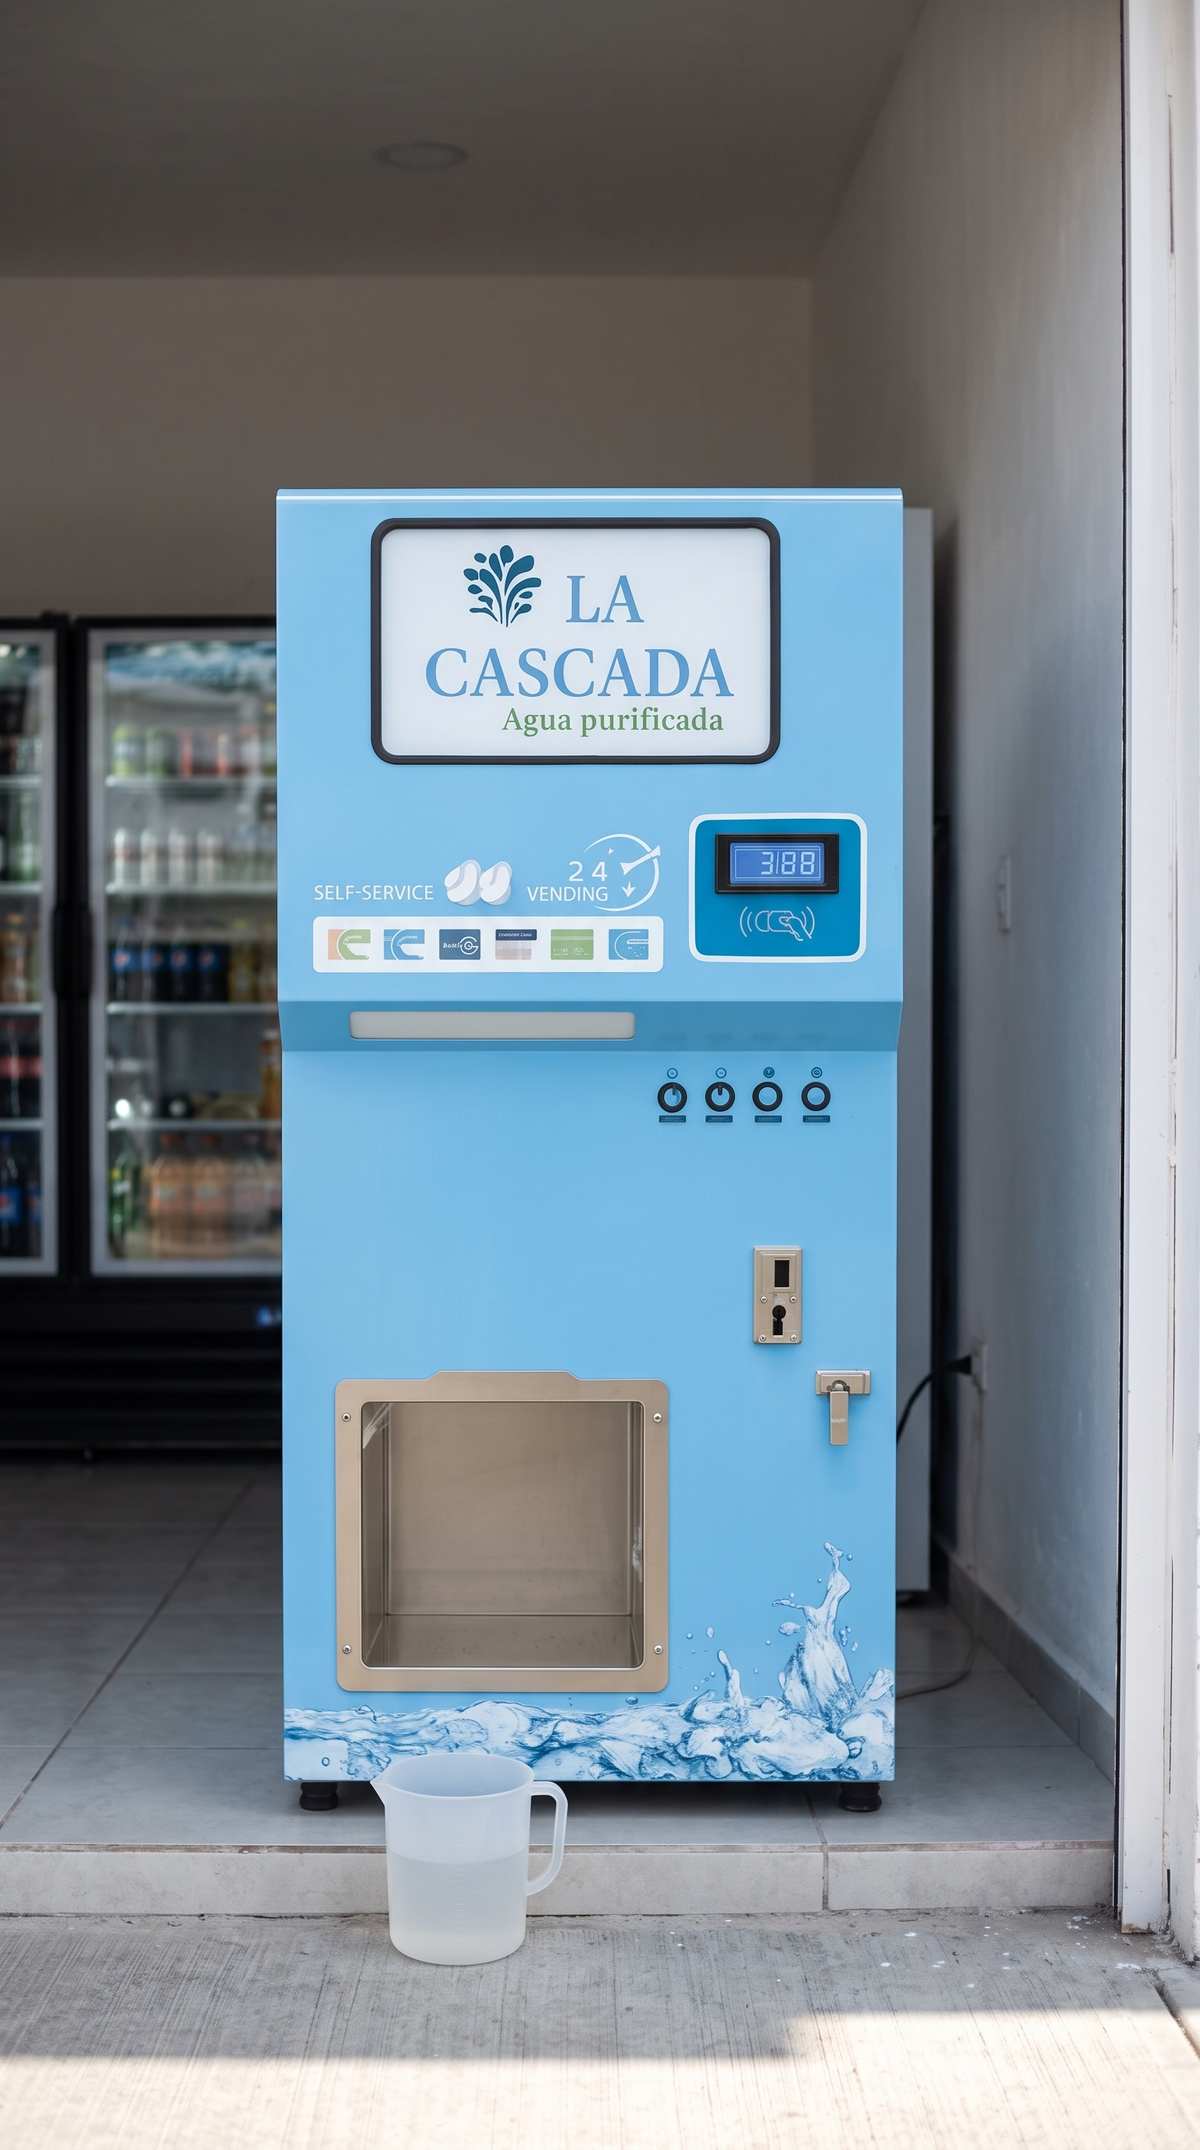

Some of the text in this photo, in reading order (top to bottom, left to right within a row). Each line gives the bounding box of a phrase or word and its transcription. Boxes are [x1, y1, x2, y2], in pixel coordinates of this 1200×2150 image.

[566, 575, 644, 623] LA
[426, 648, 734, 698] CASCADA
[502, 706, 724, 737] Agua purificada
[314, 885, 434, 901] SELF-SERVICE
[527, 886, 609, 902] VENDING
